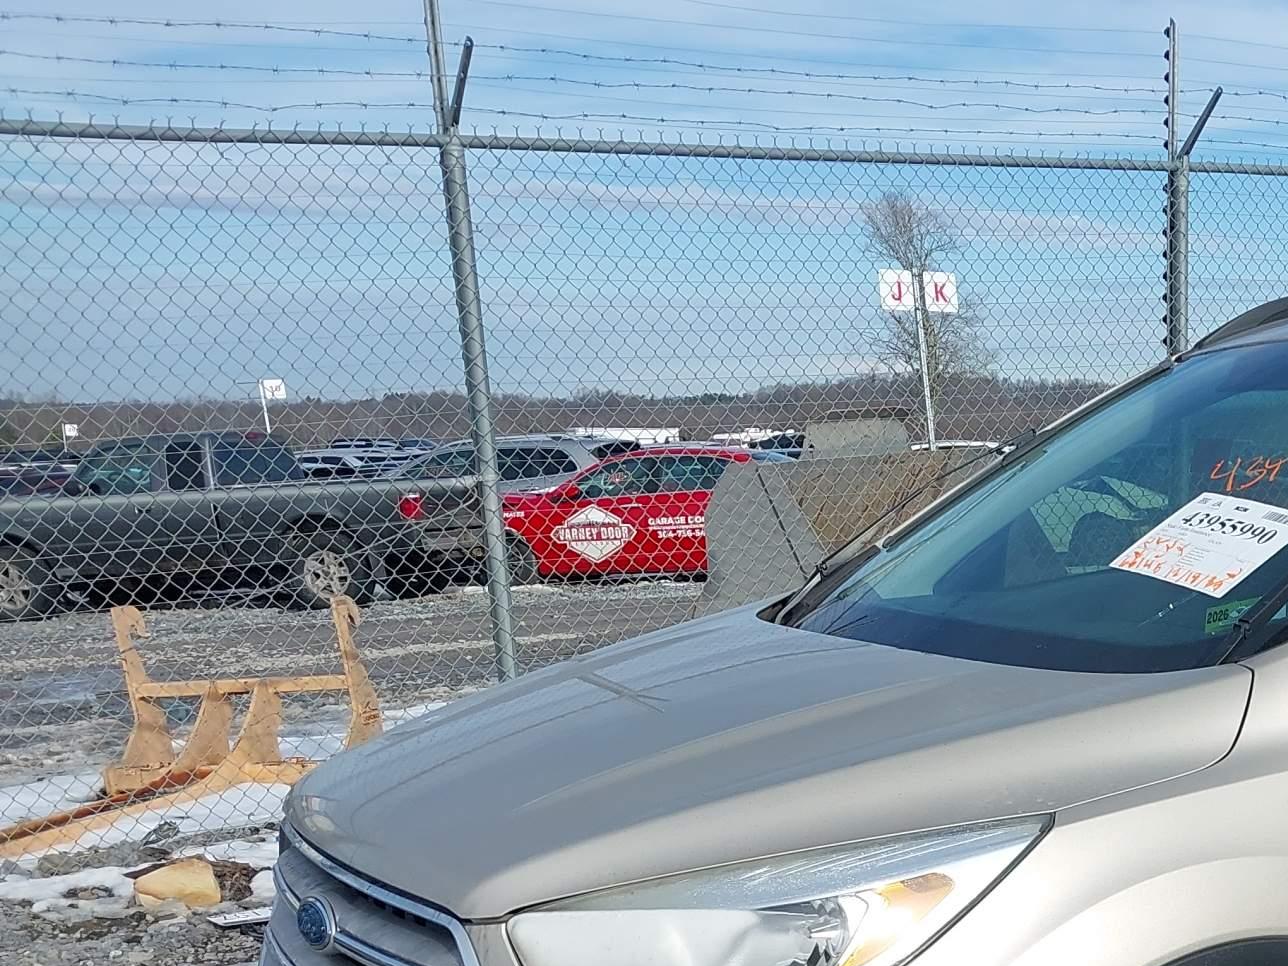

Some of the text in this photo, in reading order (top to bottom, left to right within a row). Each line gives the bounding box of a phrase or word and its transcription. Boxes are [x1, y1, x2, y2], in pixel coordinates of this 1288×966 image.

[891, 281, 902, 304] J
[933, 282, 948, 303] K
[647, 516, 686, 525] GARAGE
[1181, 511, 1279, 545] 43955990
[559, 526, 629, 541] VARNEY DOOR
[1206, 608, 1230, 625] 2026
